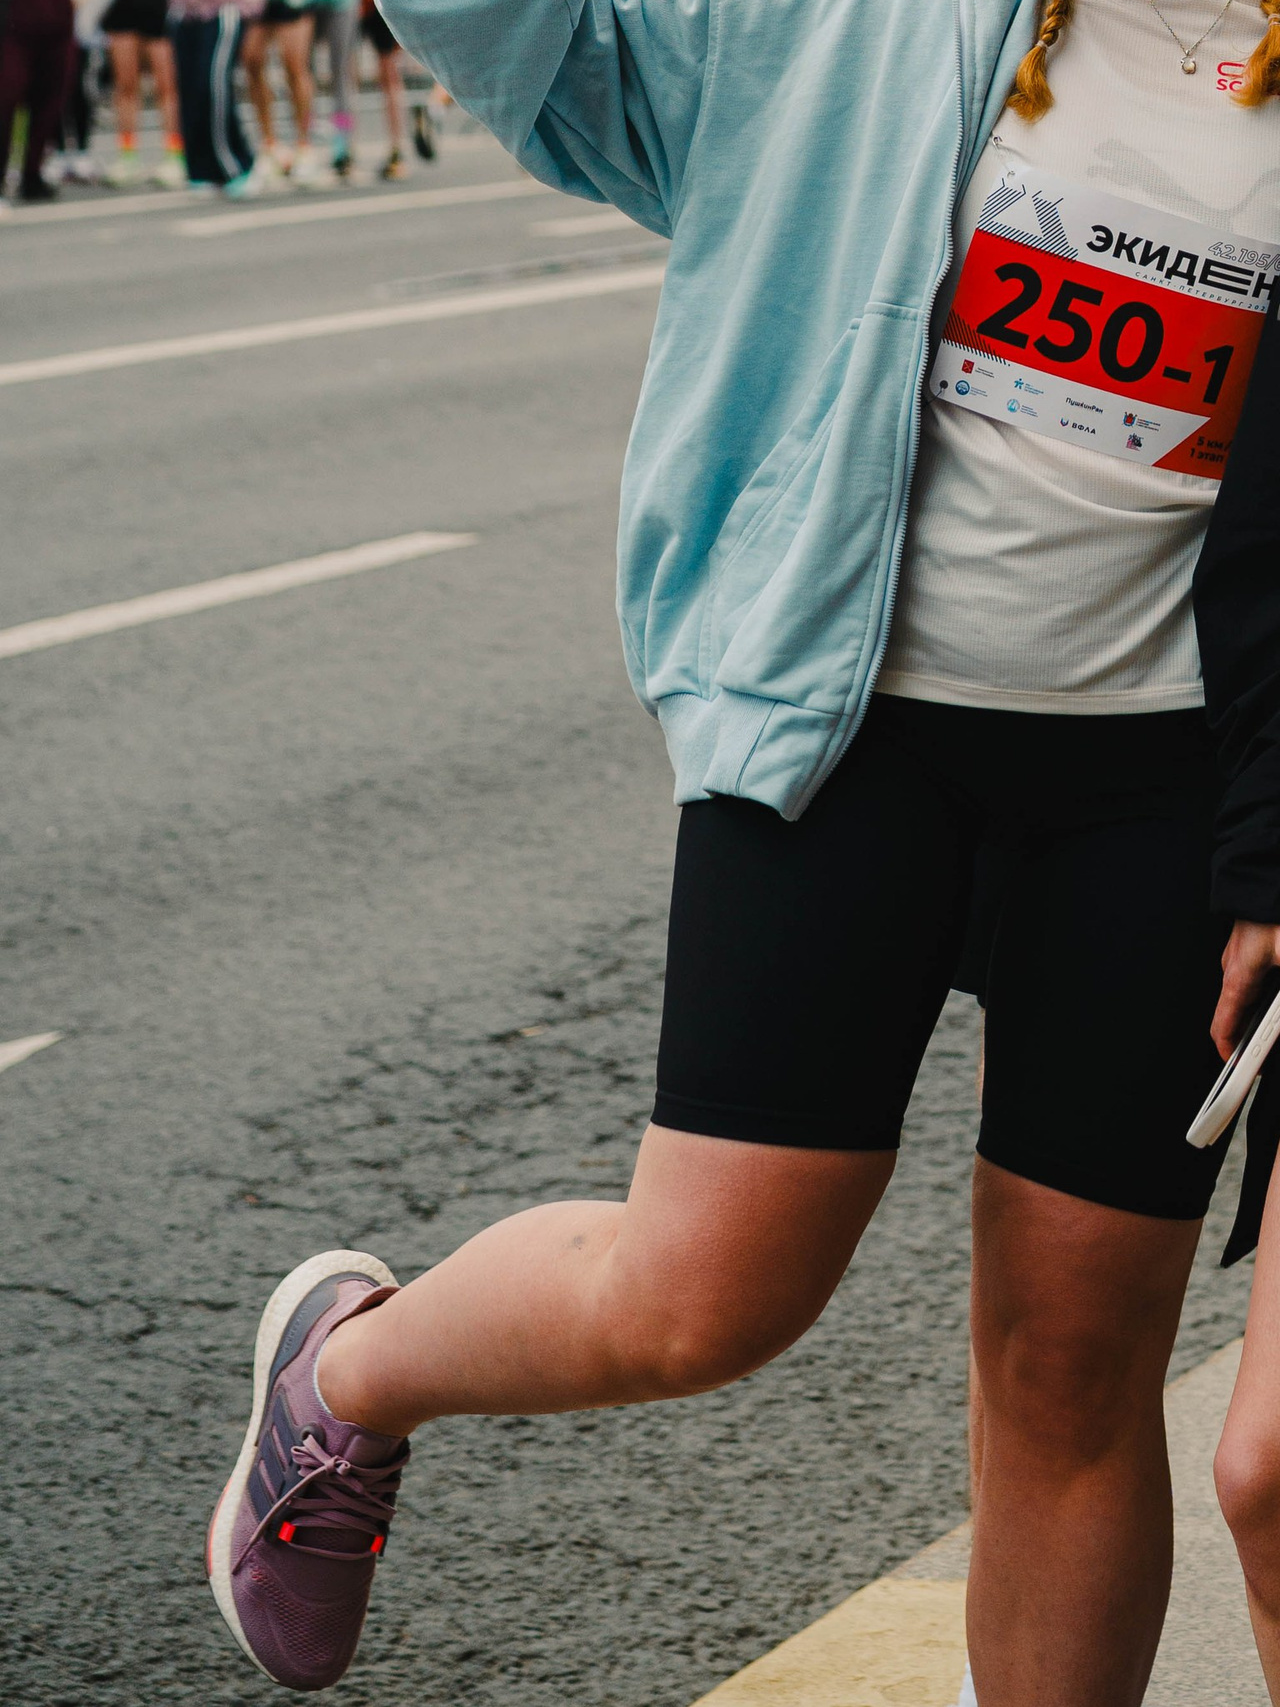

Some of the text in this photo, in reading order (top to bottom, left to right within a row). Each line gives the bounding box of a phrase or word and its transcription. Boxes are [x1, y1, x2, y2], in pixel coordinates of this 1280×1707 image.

[1135, 271, 1266, 312] САНКТ-ПЕТЕРБУРГ 202
[976, 262, 1234, 405] 250-1
[1197, 436, 1205, 446] 5
[1197, 451, 1225, 463] этап
